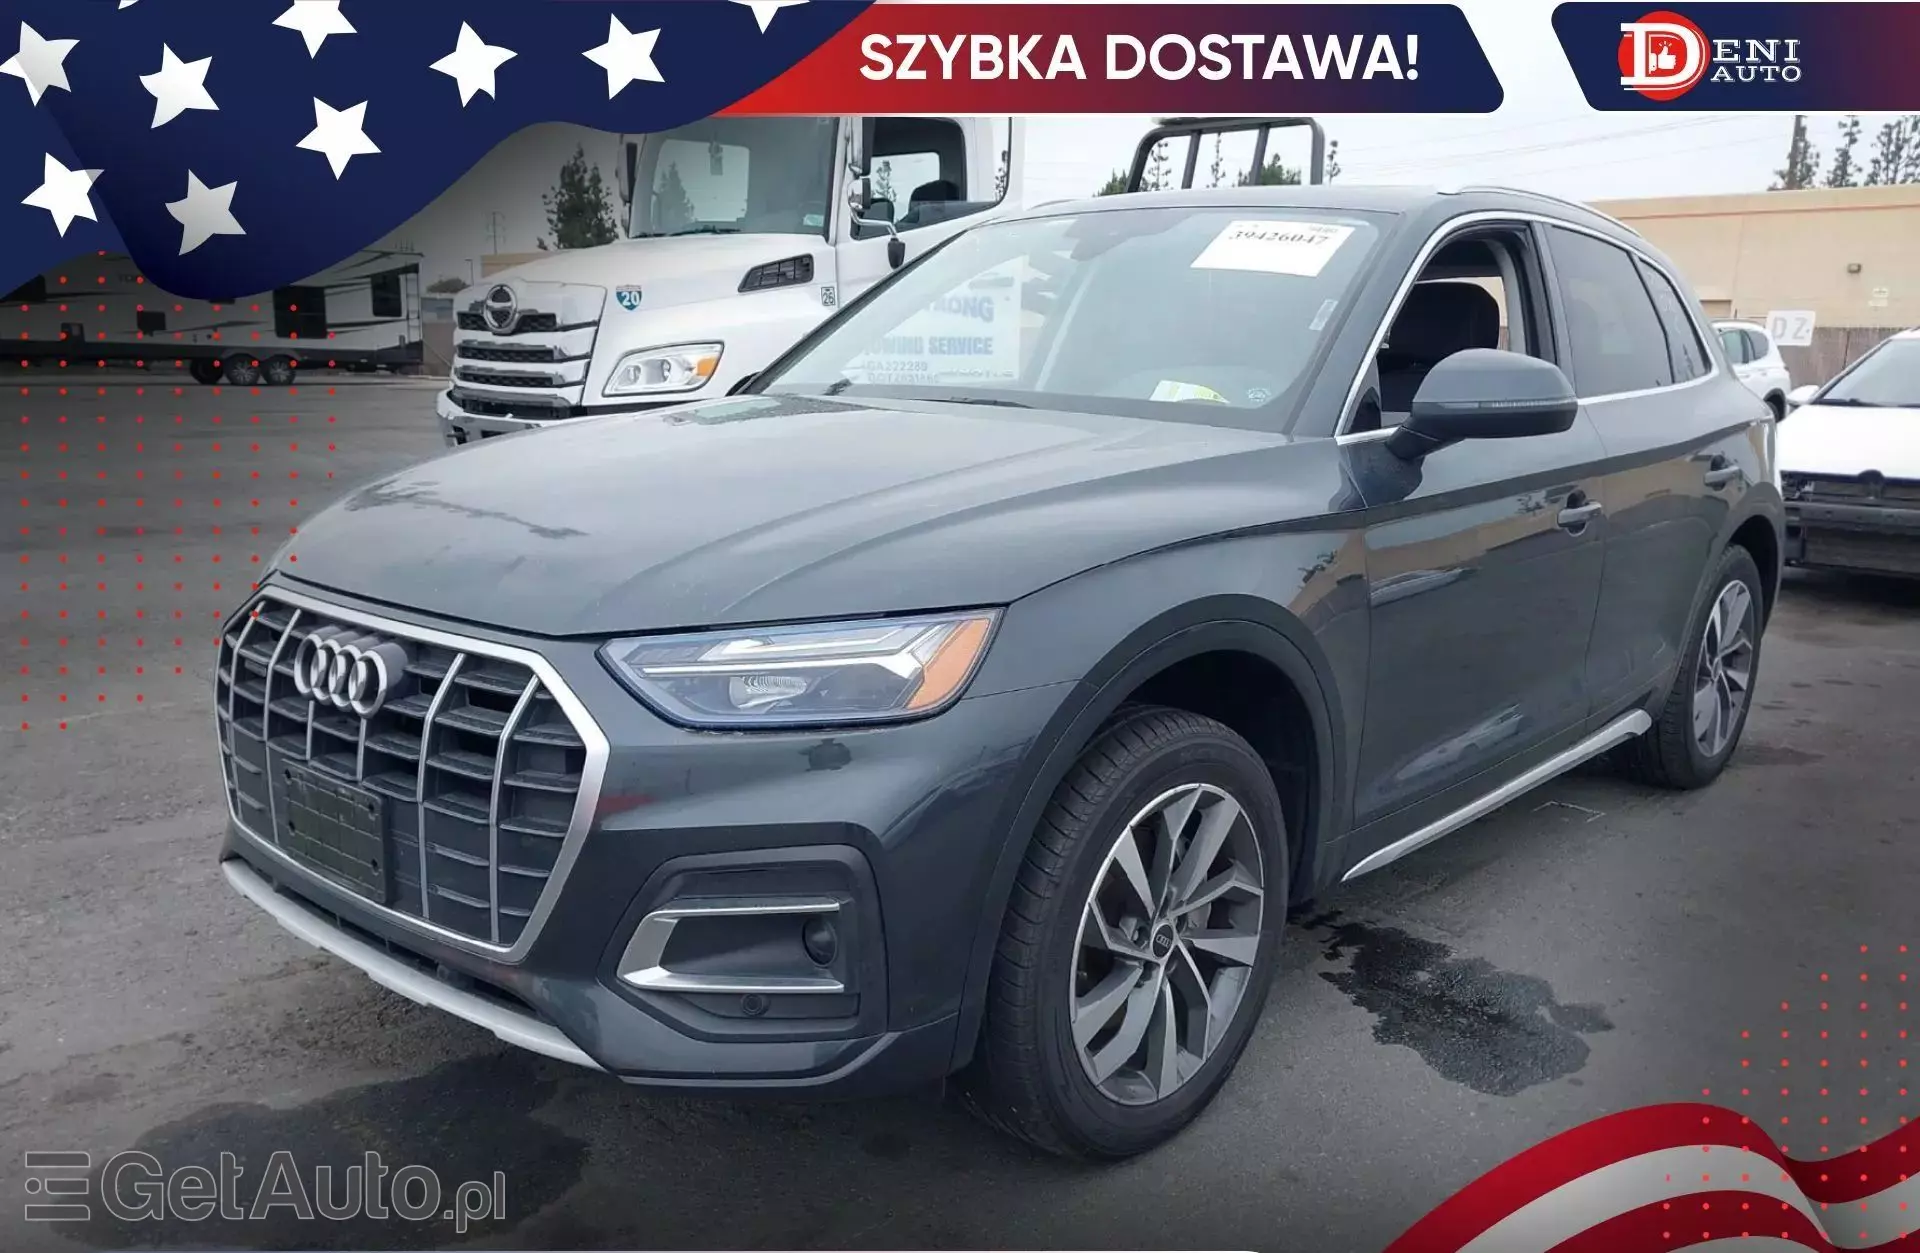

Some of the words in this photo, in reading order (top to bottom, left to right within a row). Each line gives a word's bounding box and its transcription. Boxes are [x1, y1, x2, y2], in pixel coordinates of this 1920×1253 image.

[620, 291, 640, 306] 20
[822, 292, 834, 304] 26
[929, 336, 993, 355] SERVICE
